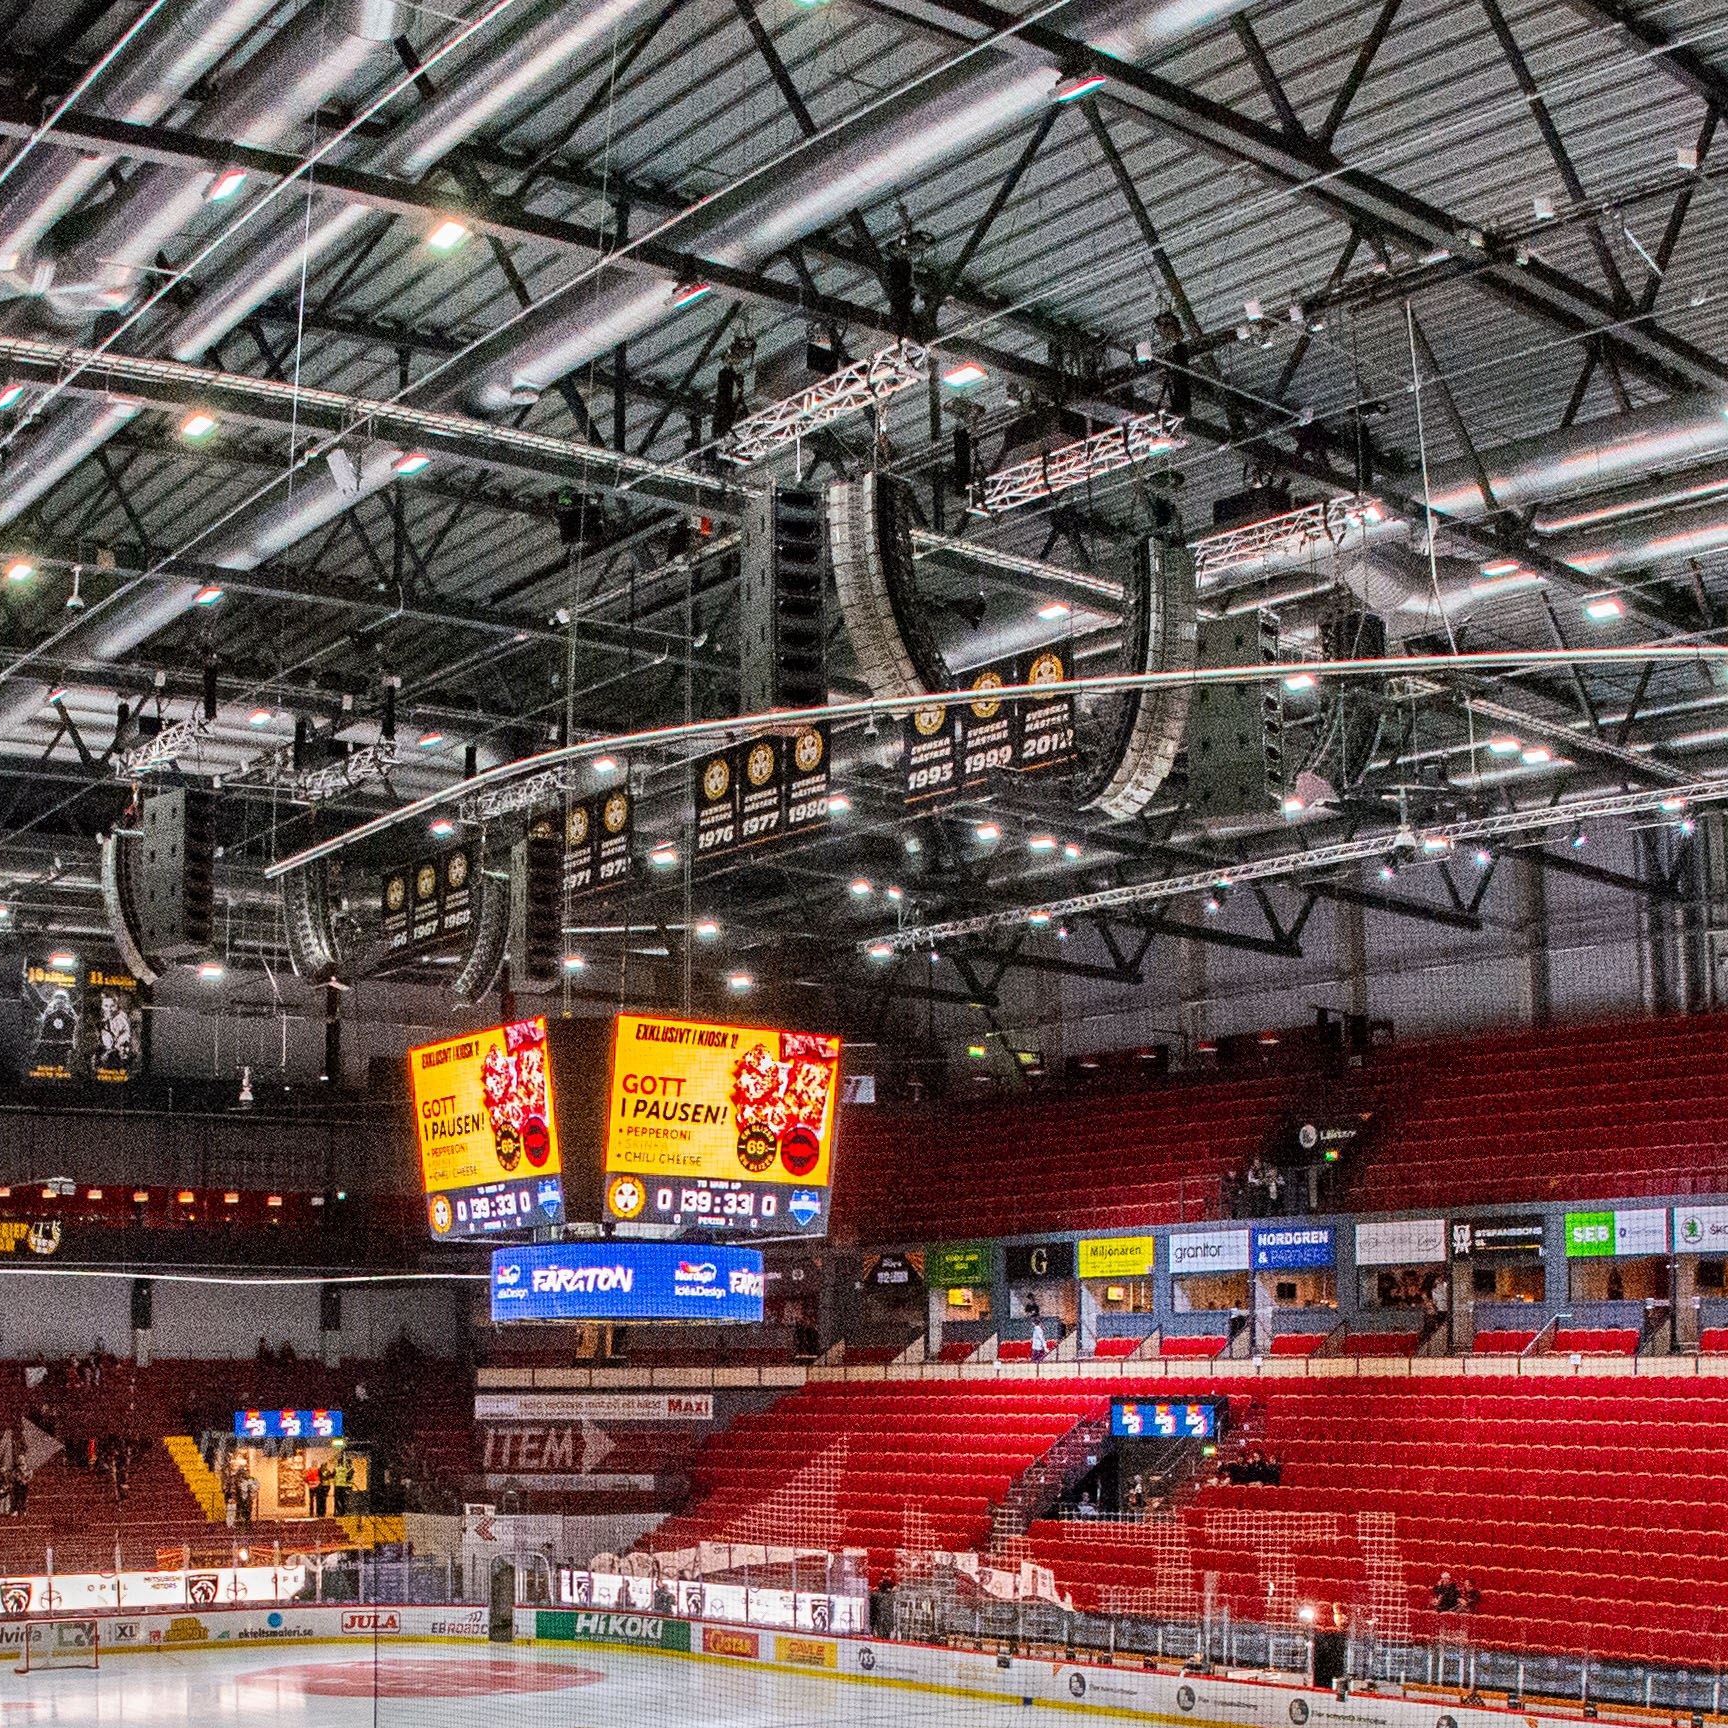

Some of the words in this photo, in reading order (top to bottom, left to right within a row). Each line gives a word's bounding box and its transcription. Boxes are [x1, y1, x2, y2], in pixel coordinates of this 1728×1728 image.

[964, 744, 1013, 776] 1999
[907, 761, 955, 792] 1993
[788, 798, 829, 824] 1980
[742, 811, 780, 837] 1977
[698, 825, 734, 850] 1976
[635, 1023, 690, 1045] EXKLUSIVT
[699, 1029, 729, 1048] KIOSK
[622, 1073, 687, 1097] GOTT
[422, 1094, 456, 1119] GOTT
[620, 1097, 627, 1118] I
[632, 1099, 729, 1125] PAUSEN!
[430, 1112, 486, 1140] PAUSEN!
[626, 1125, 692, 1141] PEPPERONI
[625, 1150, 656, 1164] CHILI
[658, 1152, 703, 1167] CHEESE
[456, 1199, 467, 1221] 0
[519, 1190, 531, 1213] 0
[657, 1188, 672, 1210] 0
[682, 1190, 752, 1215] 39:33
[762, 1194, 777, 1216] 0
[1257, 1230, 1328, 1247] NORDGREN
[1572, 1225, 1610, 1244] SEB
[1030, 1247, 1049, 1276] G
[1258, 1252, 1268, 1264] &
[1271, 1249, 1329, 1263] PARTNERS
[531, 1264, 634, 1294] FÄRGTON
[667, 1398, 710, 1415] MAXI
[483, 1426, 572, 1469] ITEM
[345, 1614, 398, 1630] JULA
